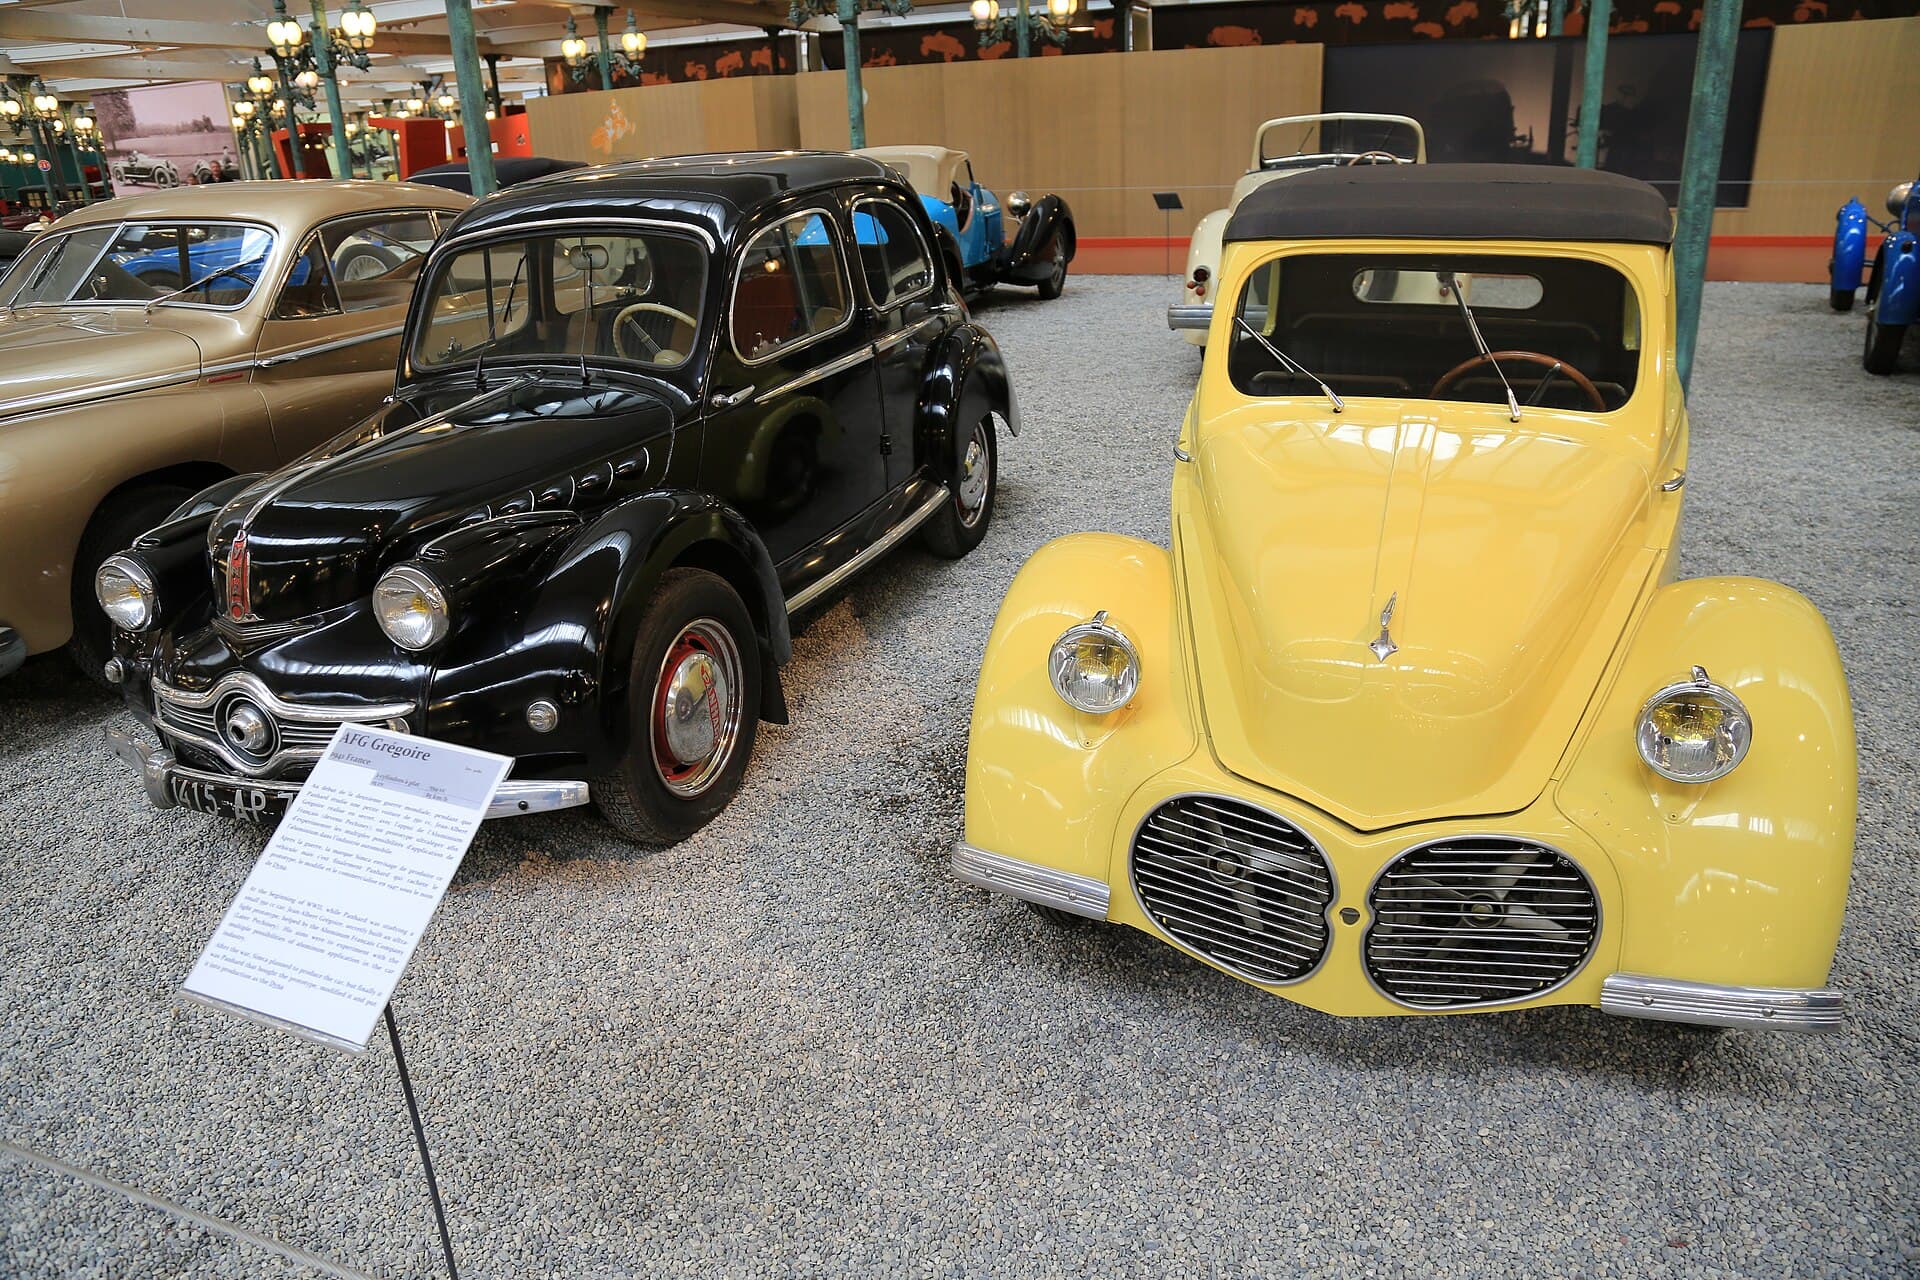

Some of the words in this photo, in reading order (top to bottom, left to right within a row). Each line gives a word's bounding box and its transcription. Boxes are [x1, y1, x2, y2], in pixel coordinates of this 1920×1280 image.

[339, 733, 369, 747] AFG
[371, 738, 430, 760] Grégoire
[346, 753, 371, 765] France
[171, 777, 218, 816] 1415
[234, 789, 266, 822] AP
